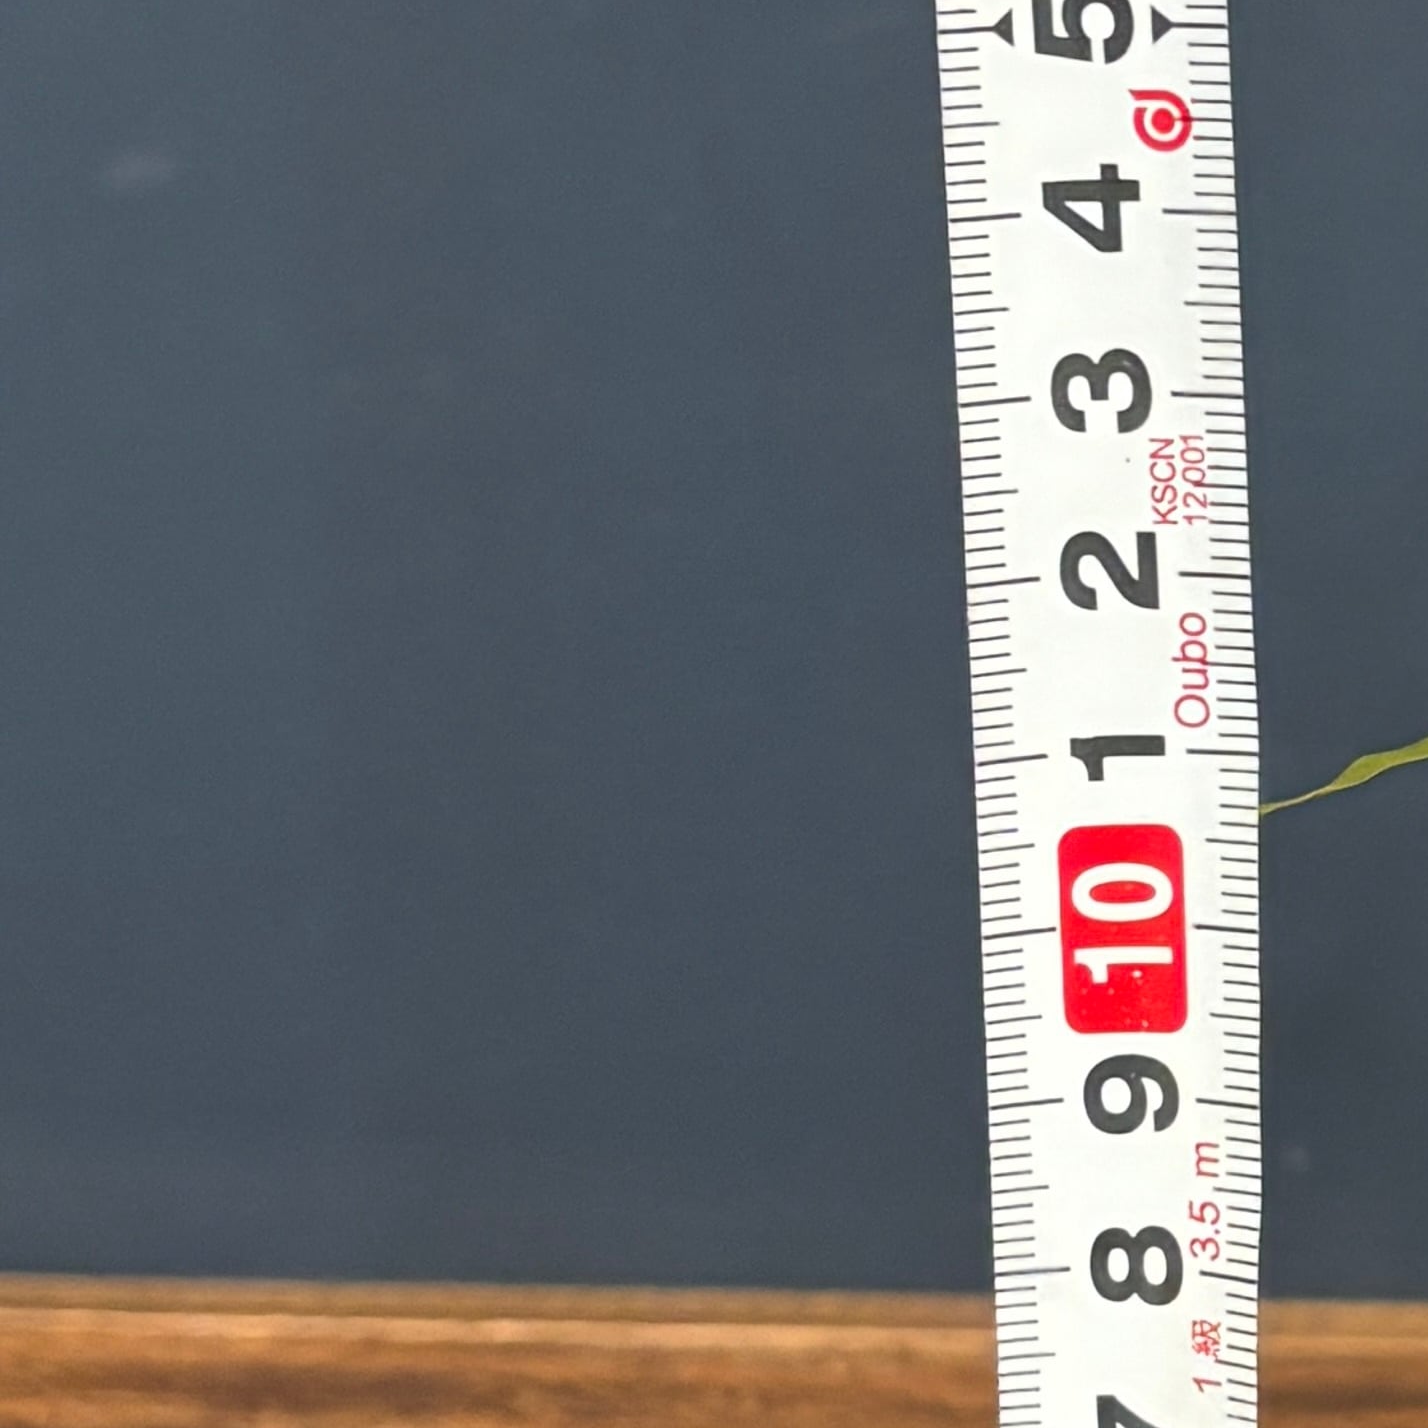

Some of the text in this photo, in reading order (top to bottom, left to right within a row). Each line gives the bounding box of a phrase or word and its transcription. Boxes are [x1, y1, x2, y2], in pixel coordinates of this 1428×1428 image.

[1042, 164, 1140, 253] 4
[1050, 347, 1152, 434] 3
[1151, 438, 1178, 525] KSCN
[1059, 531, 1160, 611] 2
[1172, 611, 1210, 728] Oubo
[1070, 734, 1166, 781] 1
[1071, 862, 1173, 984] 10
[1083, 1054, 1180, 1135] 9
[1195, 1142, 1220, 1178] m
[1089, 1225, 1184, 1306] 8
[1188, 1200, 1221, 1261] 3.5
